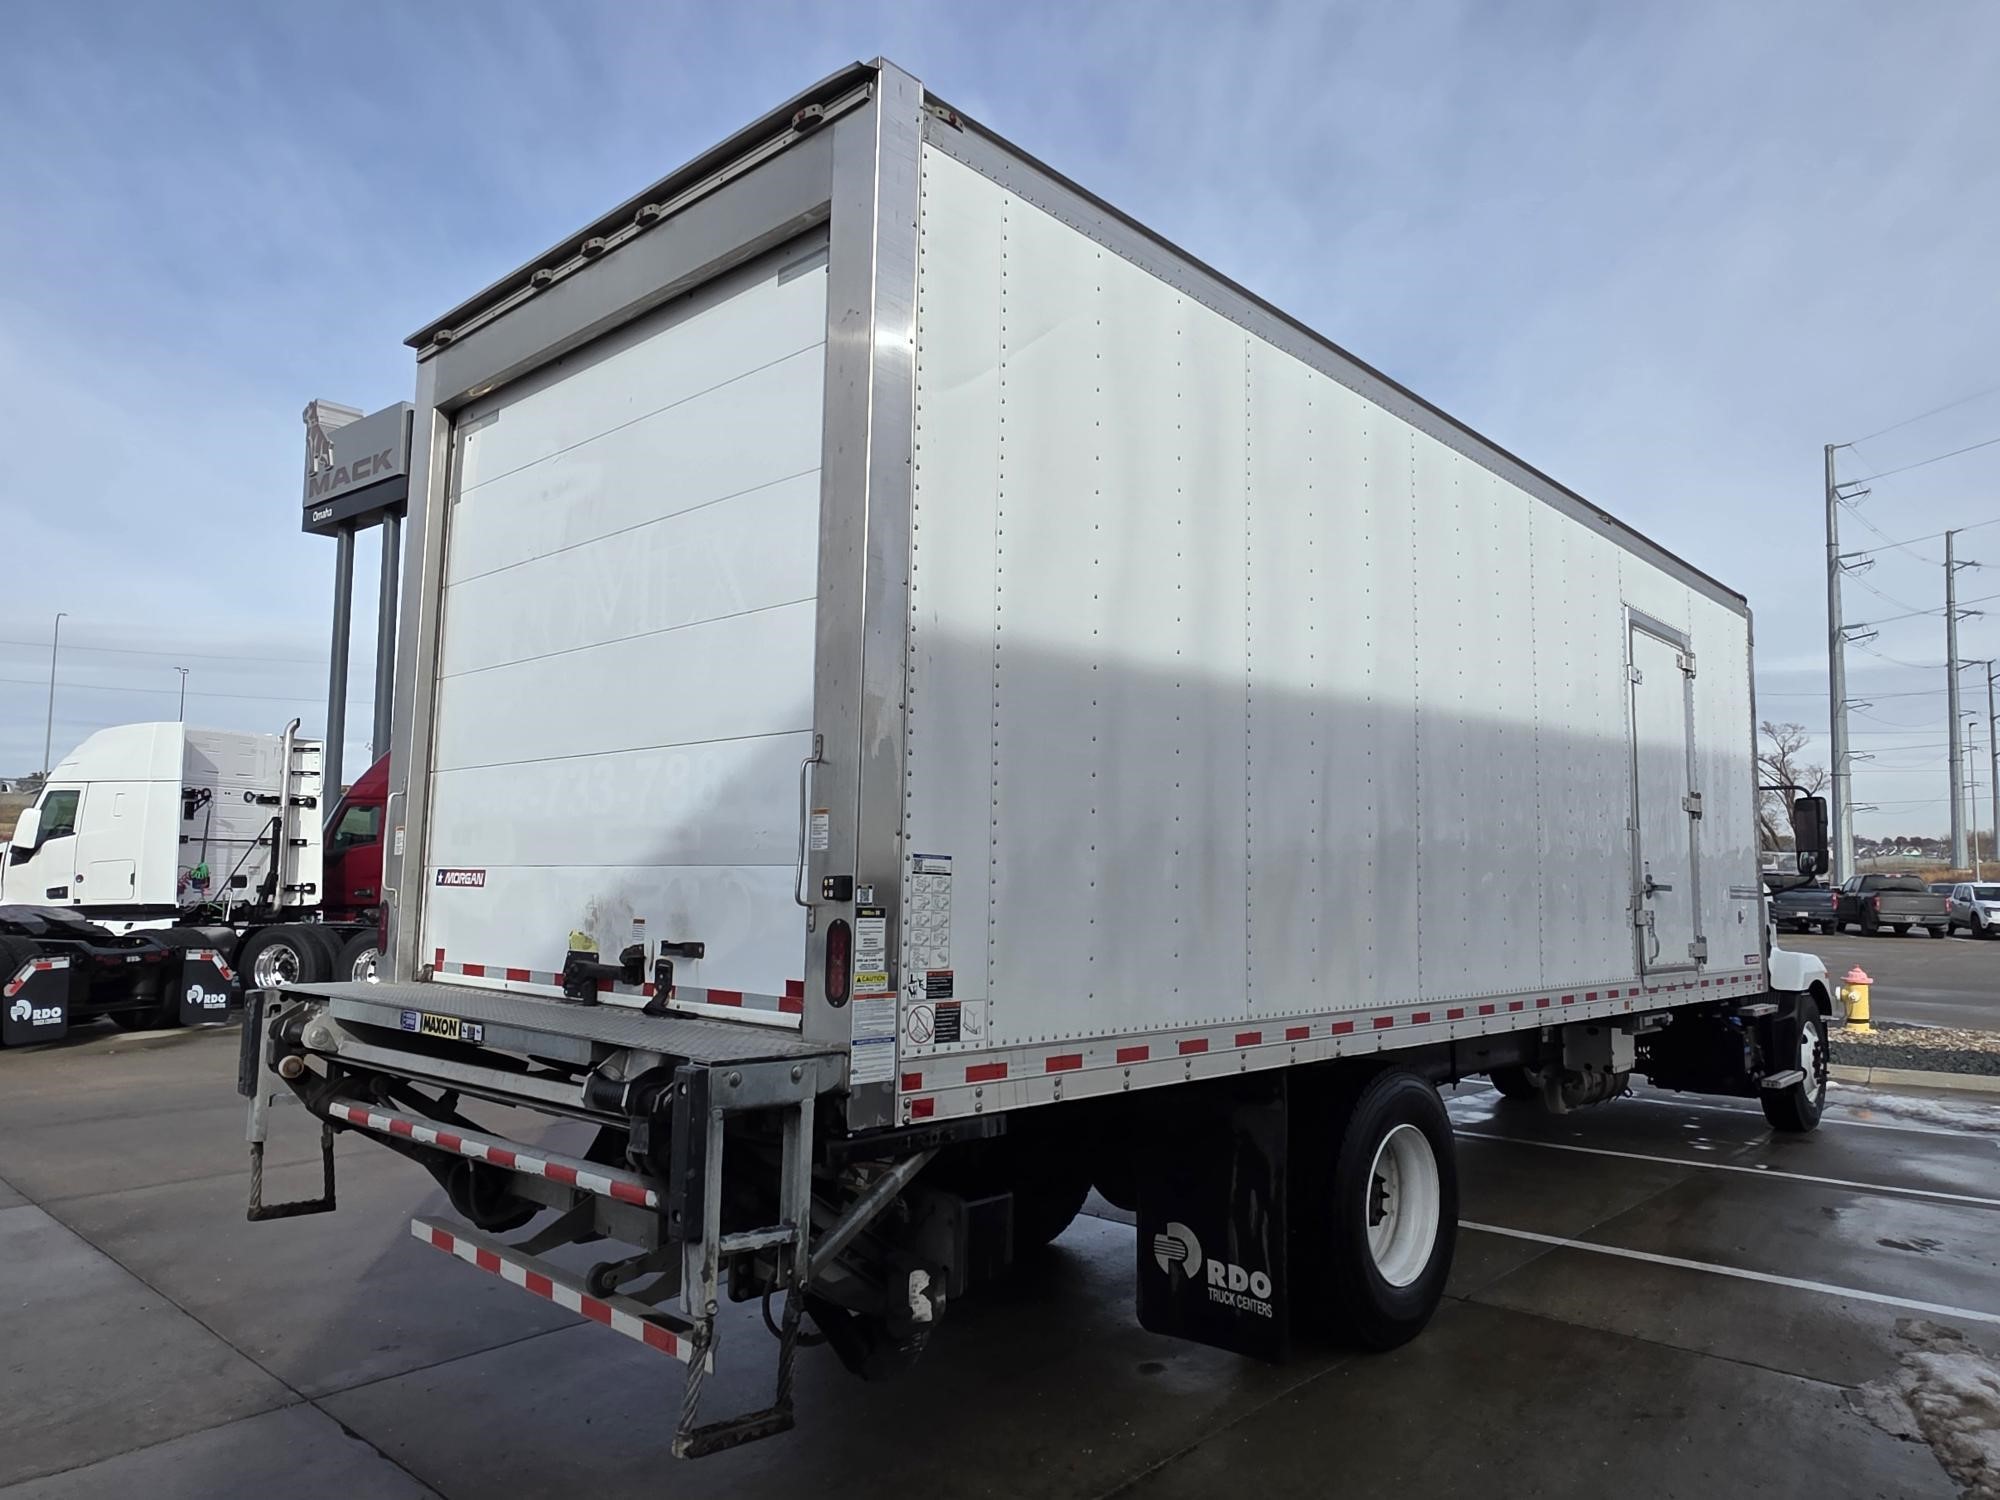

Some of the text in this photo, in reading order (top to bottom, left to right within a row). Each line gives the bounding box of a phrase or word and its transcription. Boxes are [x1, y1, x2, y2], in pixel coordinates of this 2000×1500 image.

[308, 448, 393, 498] MACK
[312, 507, 333, 522] Omaha
[444, 871, 485, 886] MORGAN
[861, 975, 886, 983] CAUTION
[204, 994, 227, 1004] RDO
[32, 1006, 62, 1020] RDO
[423, 1015, 458, 1037] MAXON
[1207, 1258, 1272, 1299] RDO
[1208, 1287, 1273, 1318] TRUCK CENTERS
